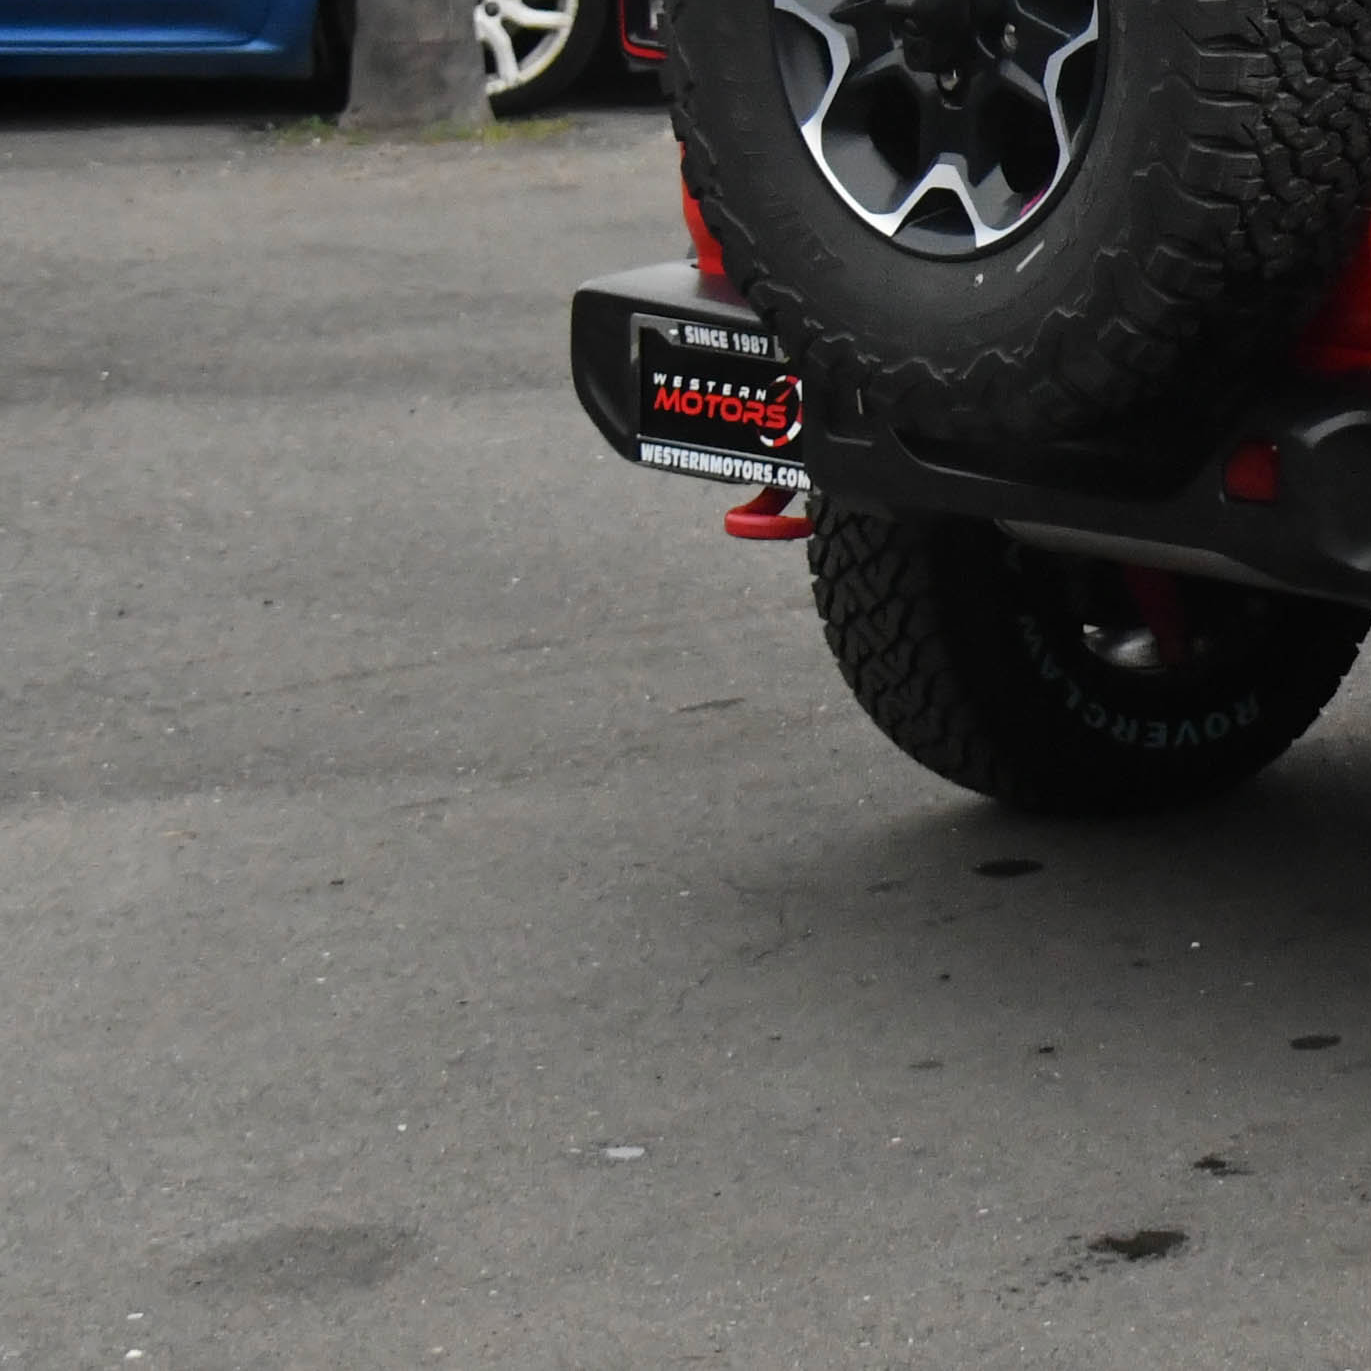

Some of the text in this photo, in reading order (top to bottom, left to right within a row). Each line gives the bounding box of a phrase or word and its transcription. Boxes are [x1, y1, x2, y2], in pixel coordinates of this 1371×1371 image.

[684, 325, 769, 355] SINCE 1987
[653, 372, 767, 402] WESTERN
[653, 387, 787, 430] MOTORS
[641, 442, 811, 489] WESTERNMOTORS.COM
